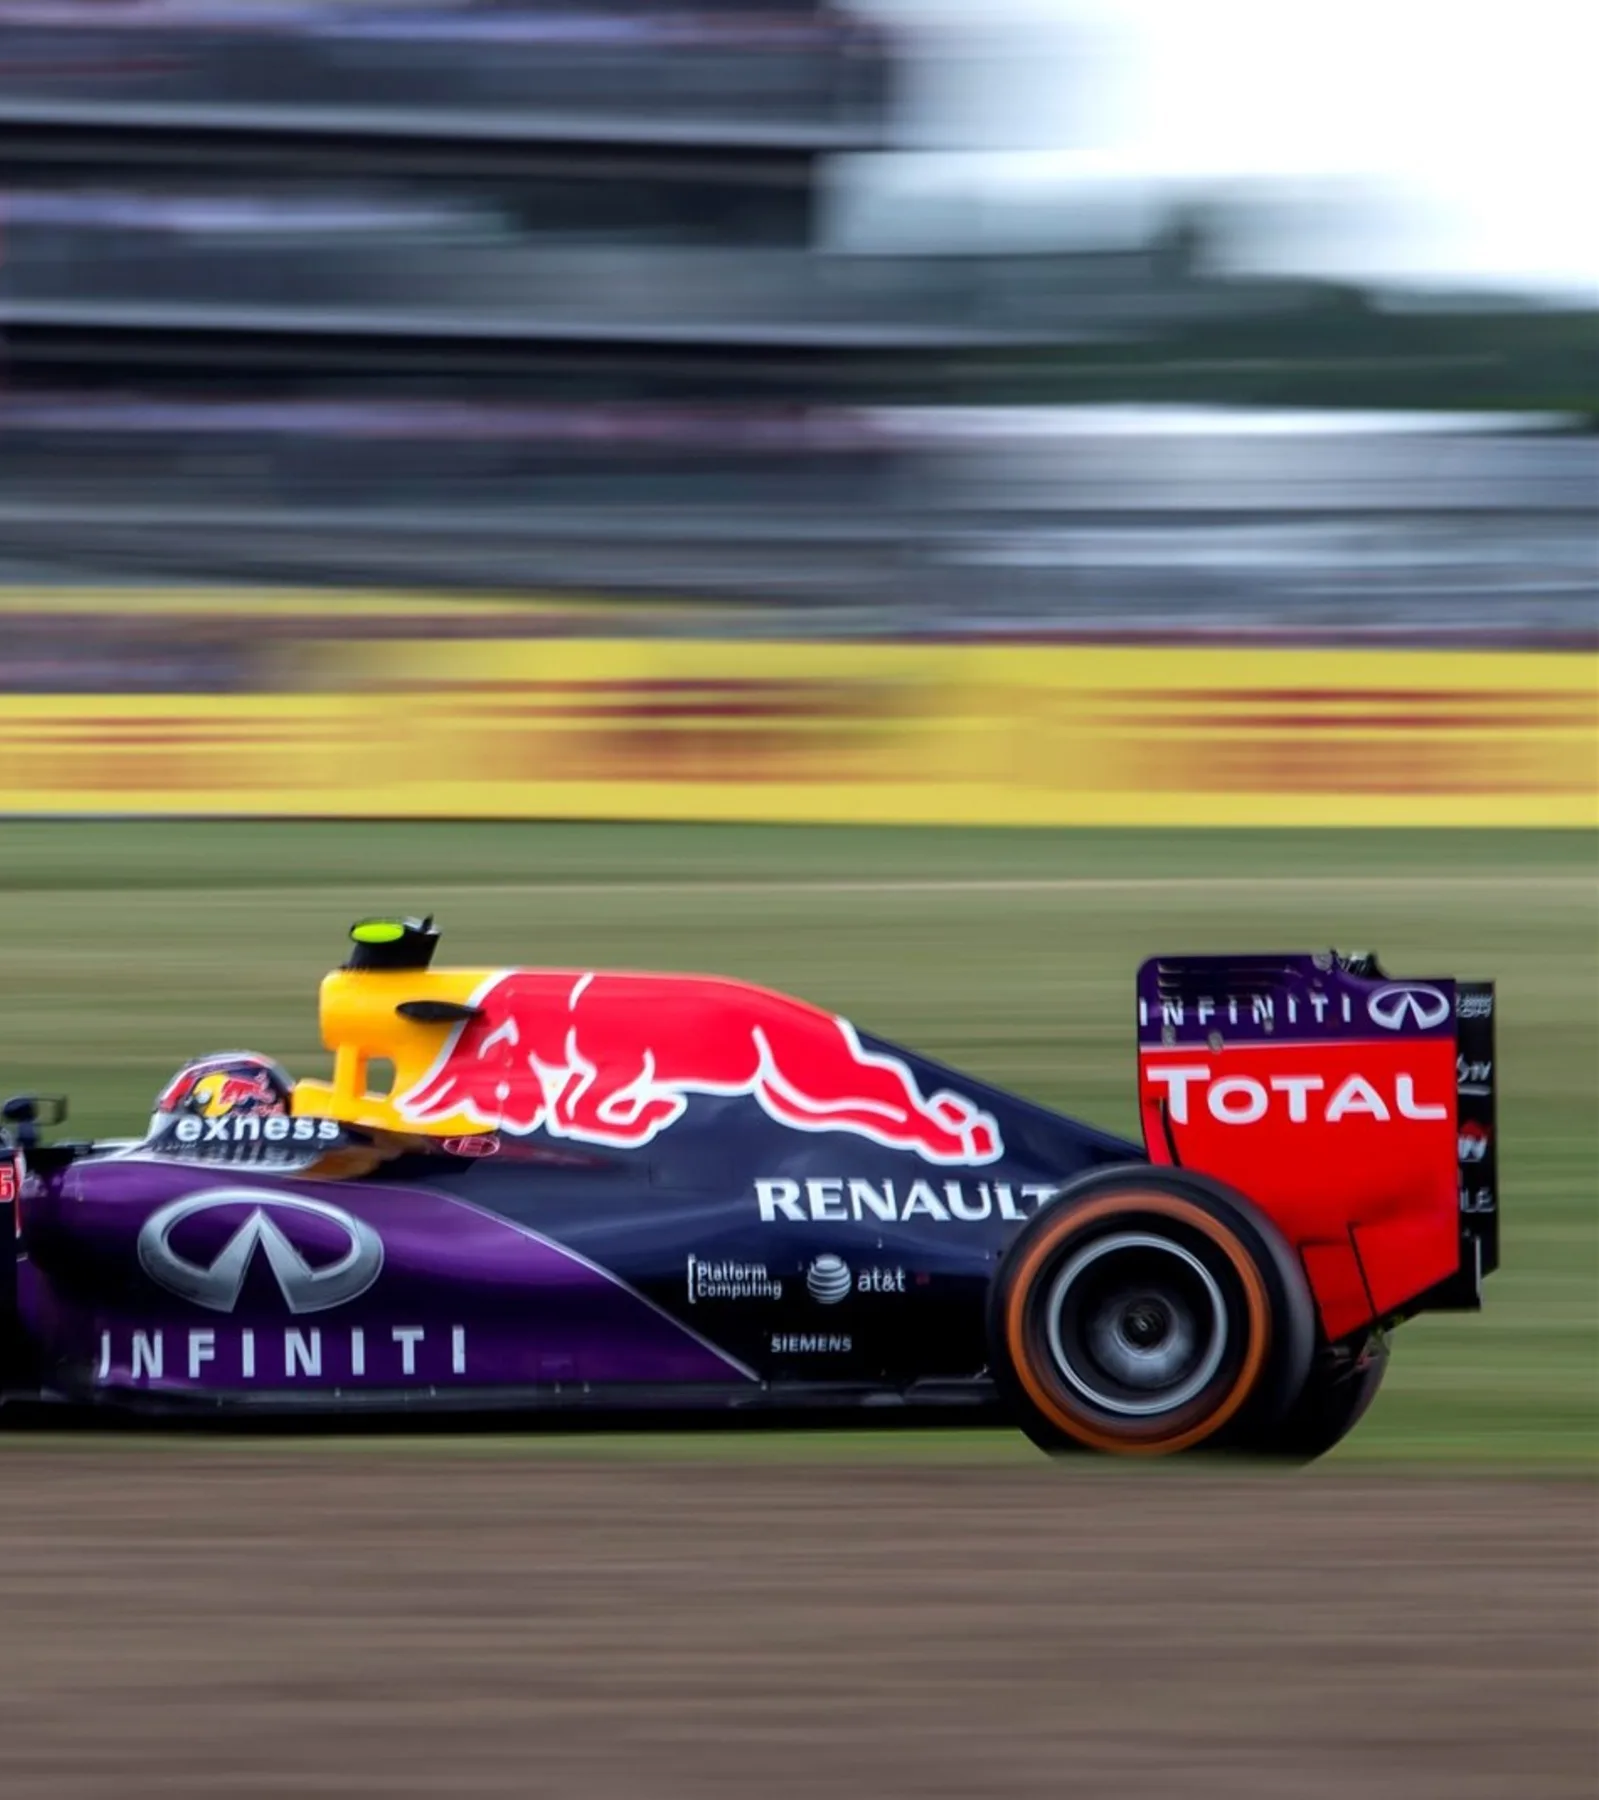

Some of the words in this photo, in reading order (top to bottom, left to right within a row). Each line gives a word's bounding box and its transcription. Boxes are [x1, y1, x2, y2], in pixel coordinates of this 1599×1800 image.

[1139, 992, 1351, 1026] INFINITI
[1146, 1064, 1447, 1126] TOTAL
[175, 1114, 340, 1142] exness
[696, 1259, 768, 1282] Platform
[696, 1278, 783, 1300] Computing
[98, 1324, 466, 1379] INFINITI
[770, 1333, 852, 1353] SIEMENS
